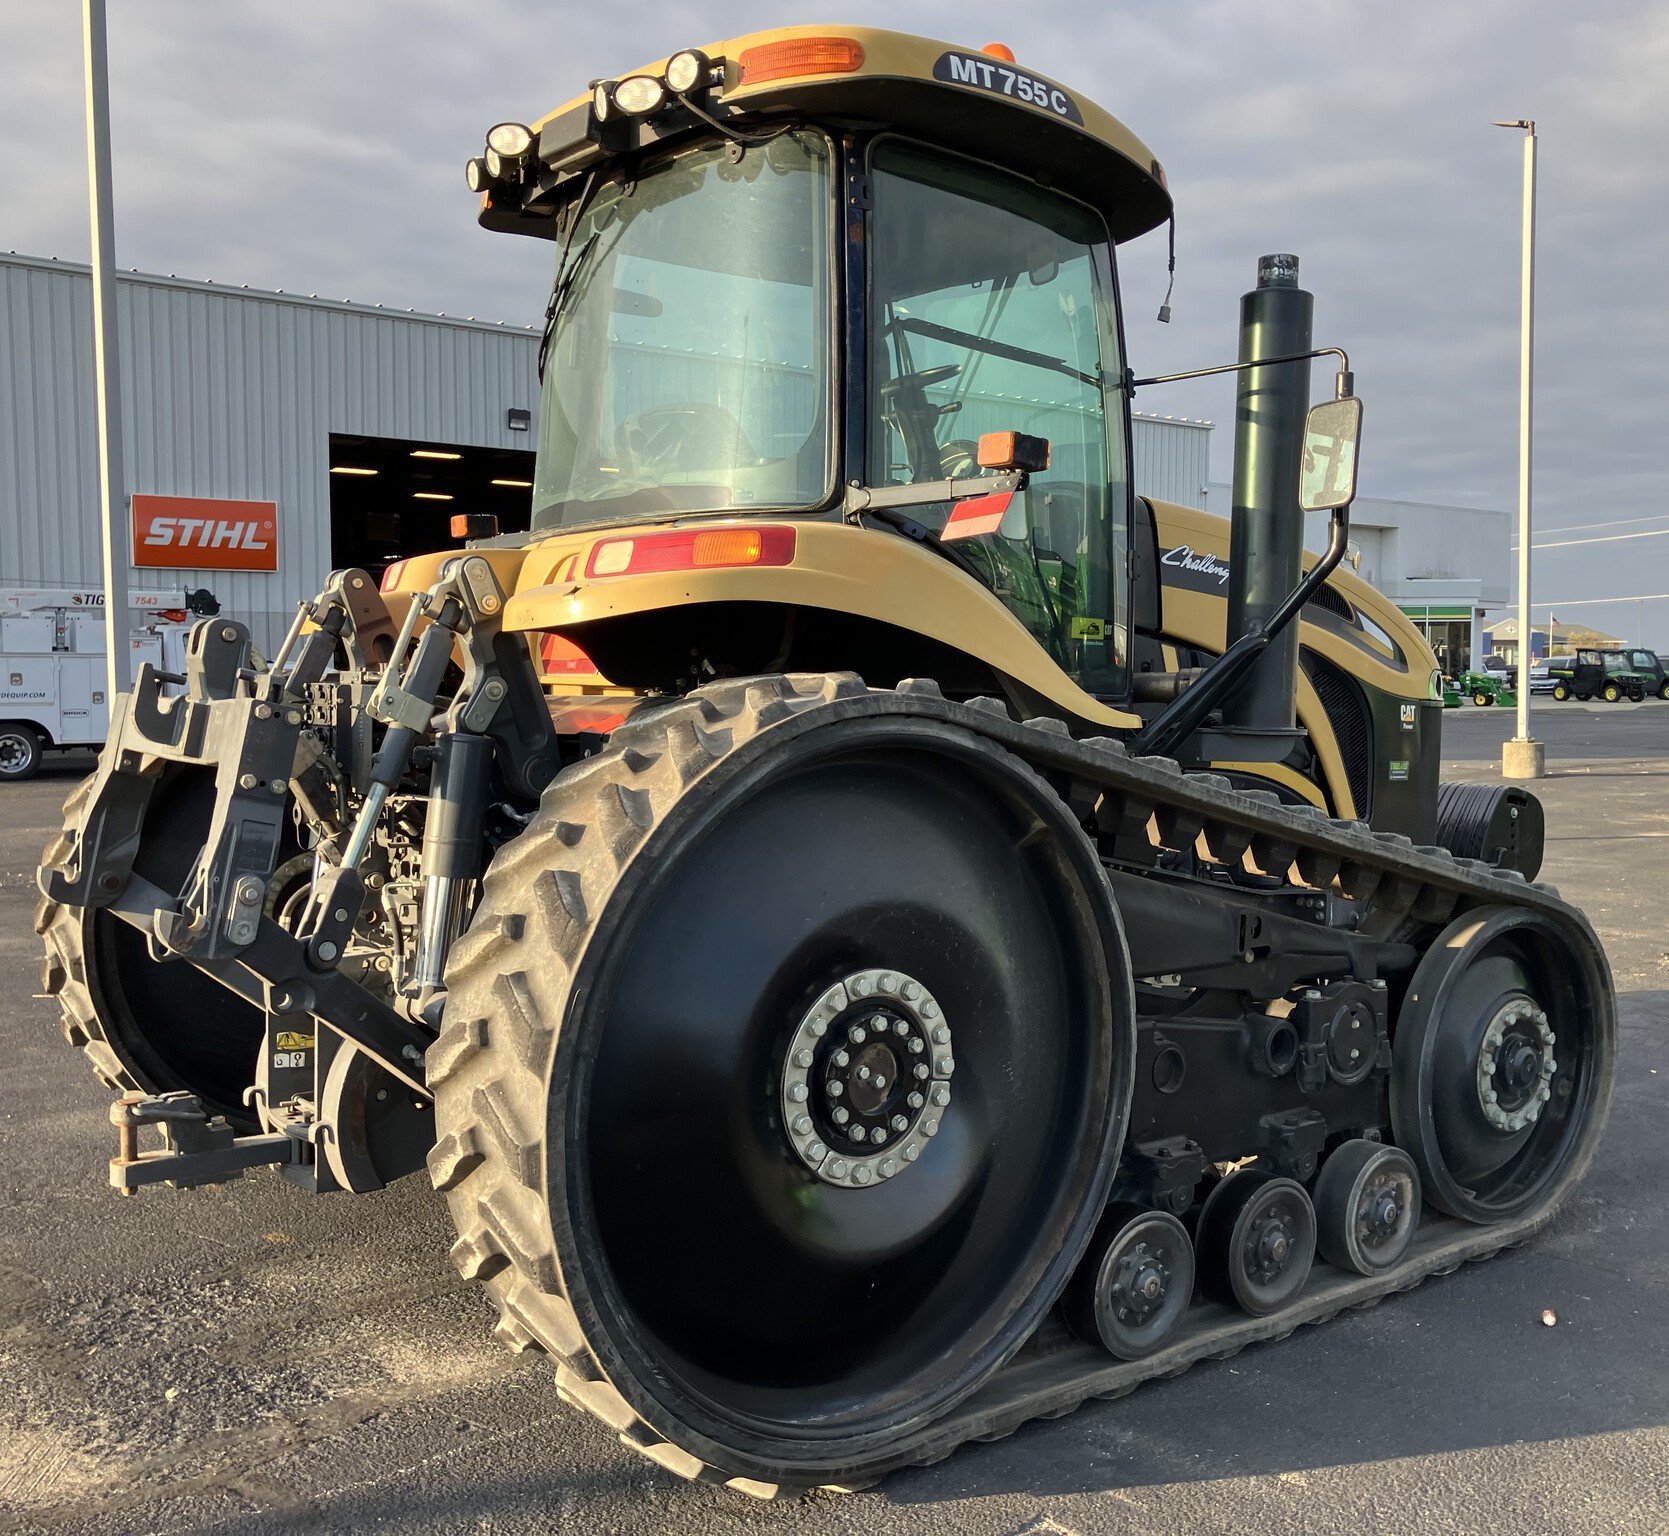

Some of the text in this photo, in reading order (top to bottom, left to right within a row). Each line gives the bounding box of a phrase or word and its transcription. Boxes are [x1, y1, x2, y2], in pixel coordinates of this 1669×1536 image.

[144, 516, 268, 550] STIHL
[1161, 545, 1229, 584] Challeng
[84, 594, 105, 605] TIG
[135, 597, 158, 605] 7543
[1400, 704, 1416, 722] CAT
